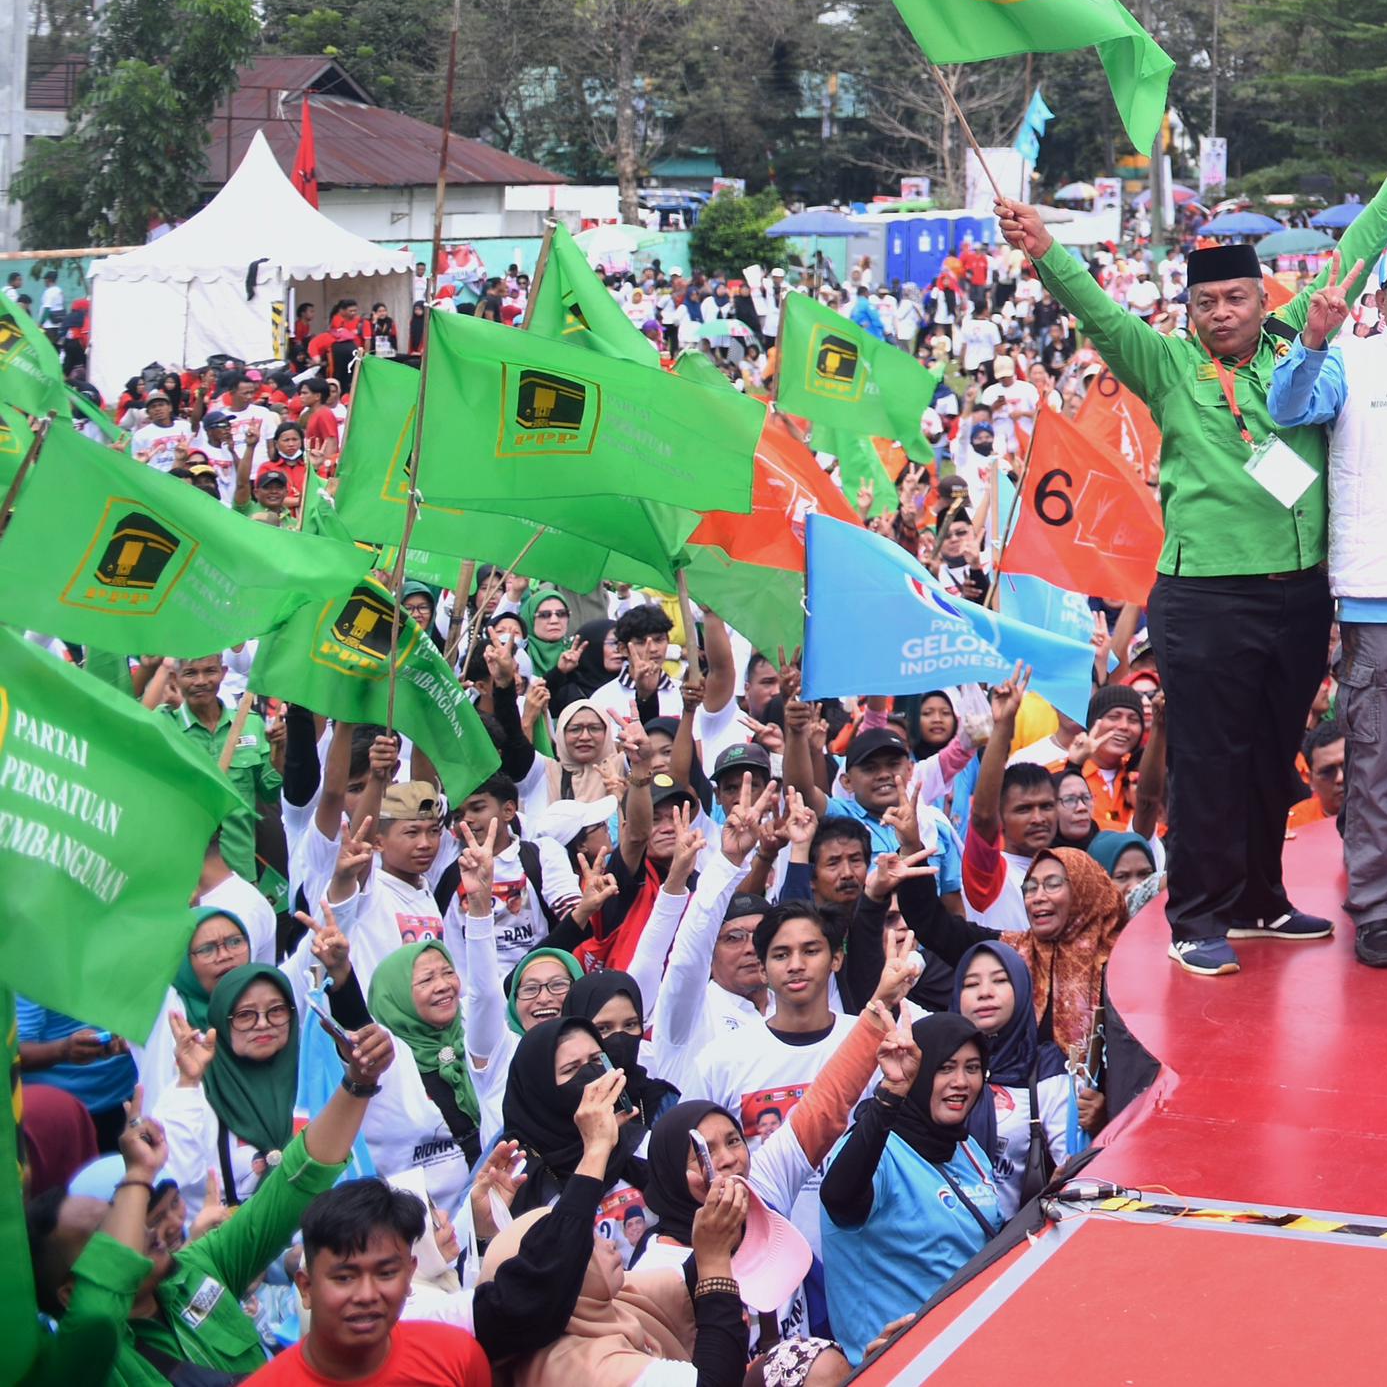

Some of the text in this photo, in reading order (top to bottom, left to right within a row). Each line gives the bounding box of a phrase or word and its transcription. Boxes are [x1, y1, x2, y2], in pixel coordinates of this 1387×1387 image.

[515, 433, 580, 446] PPP
[1034, 468, 1074, 527] 6
[84, 587, 151, 605] PPP
[930, 618, 970, 633] PAR
[14, 708, 89, 767] PARTAI
[0, 754, 123, 837] PERSATUAN
[0, 809, 129, 905] EMBANGUNAN
[412, 1140, 455, 1162] RIDHA
